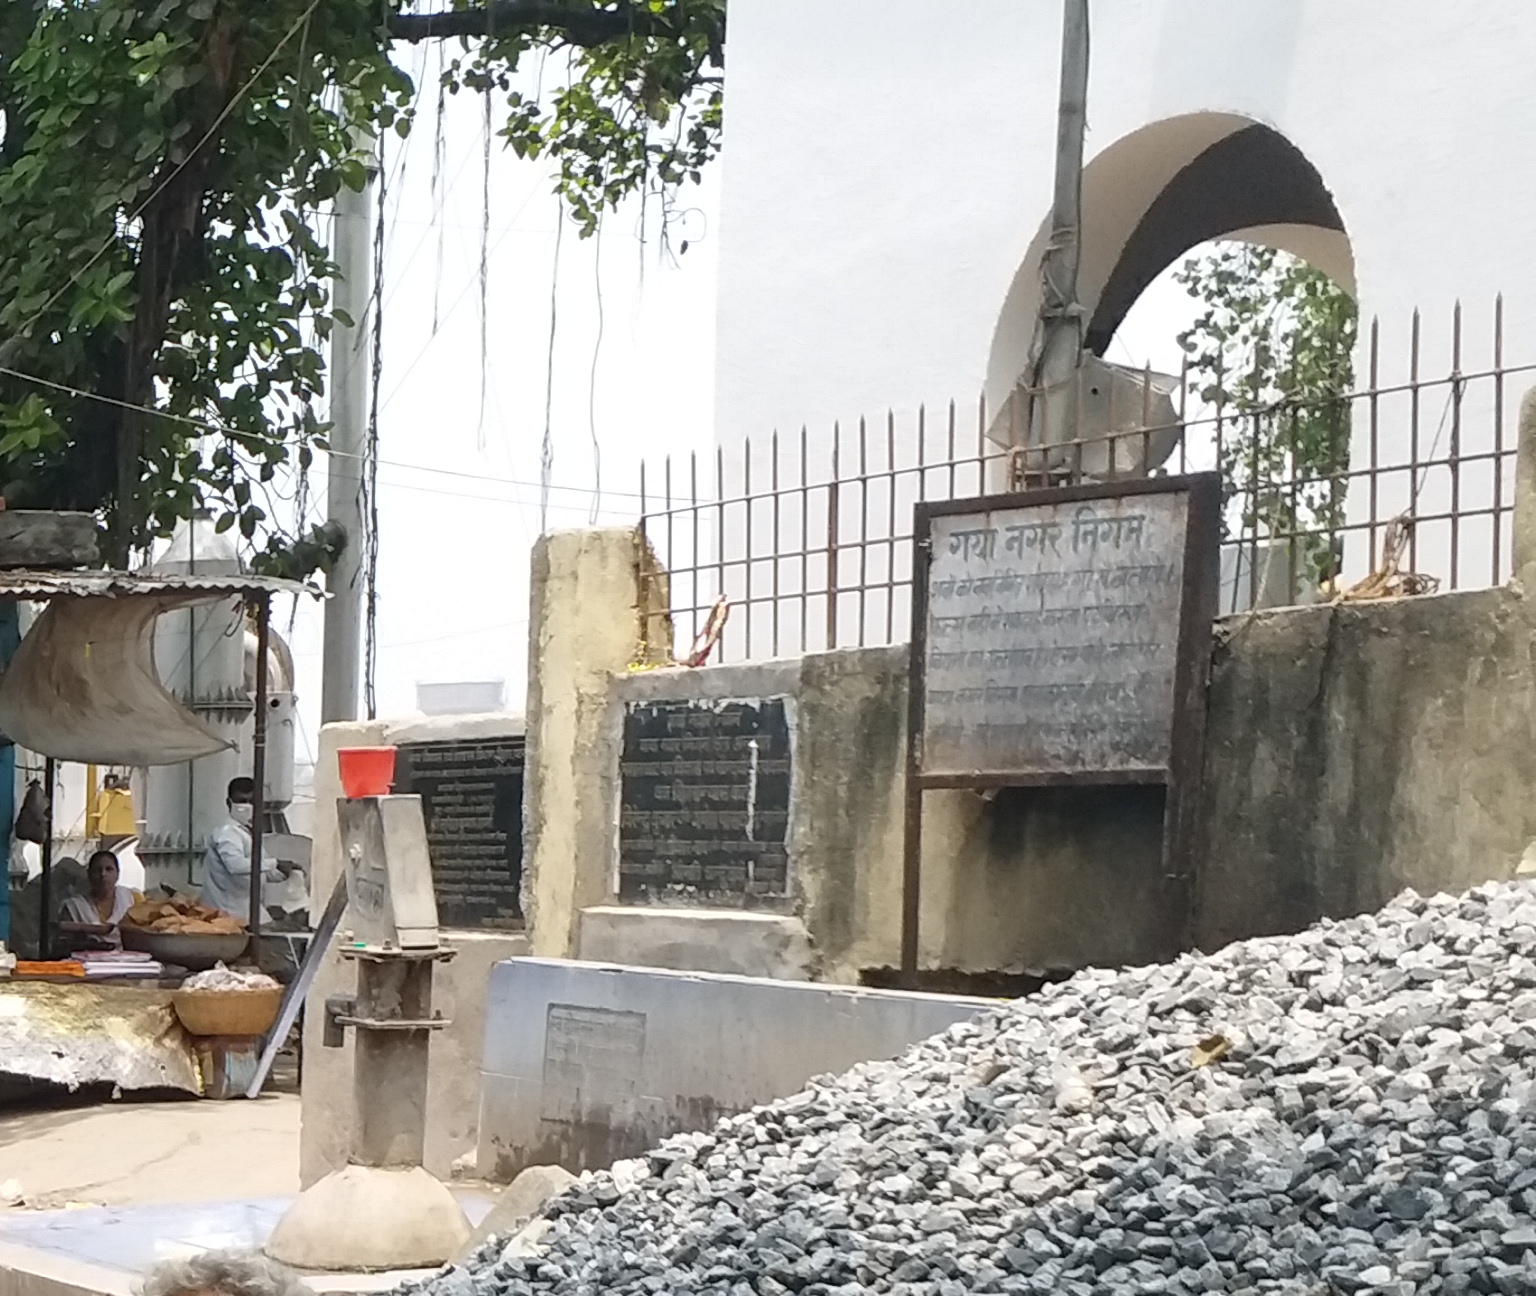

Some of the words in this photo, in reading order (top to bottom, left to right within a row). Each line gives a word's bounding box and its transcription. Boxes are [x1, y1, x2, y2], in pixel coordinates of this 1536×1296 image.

[949, 528, 998, 563] गया
[1005, 522, 1062, 559] नगर
[1072, 506, 1146, 553] निगम
